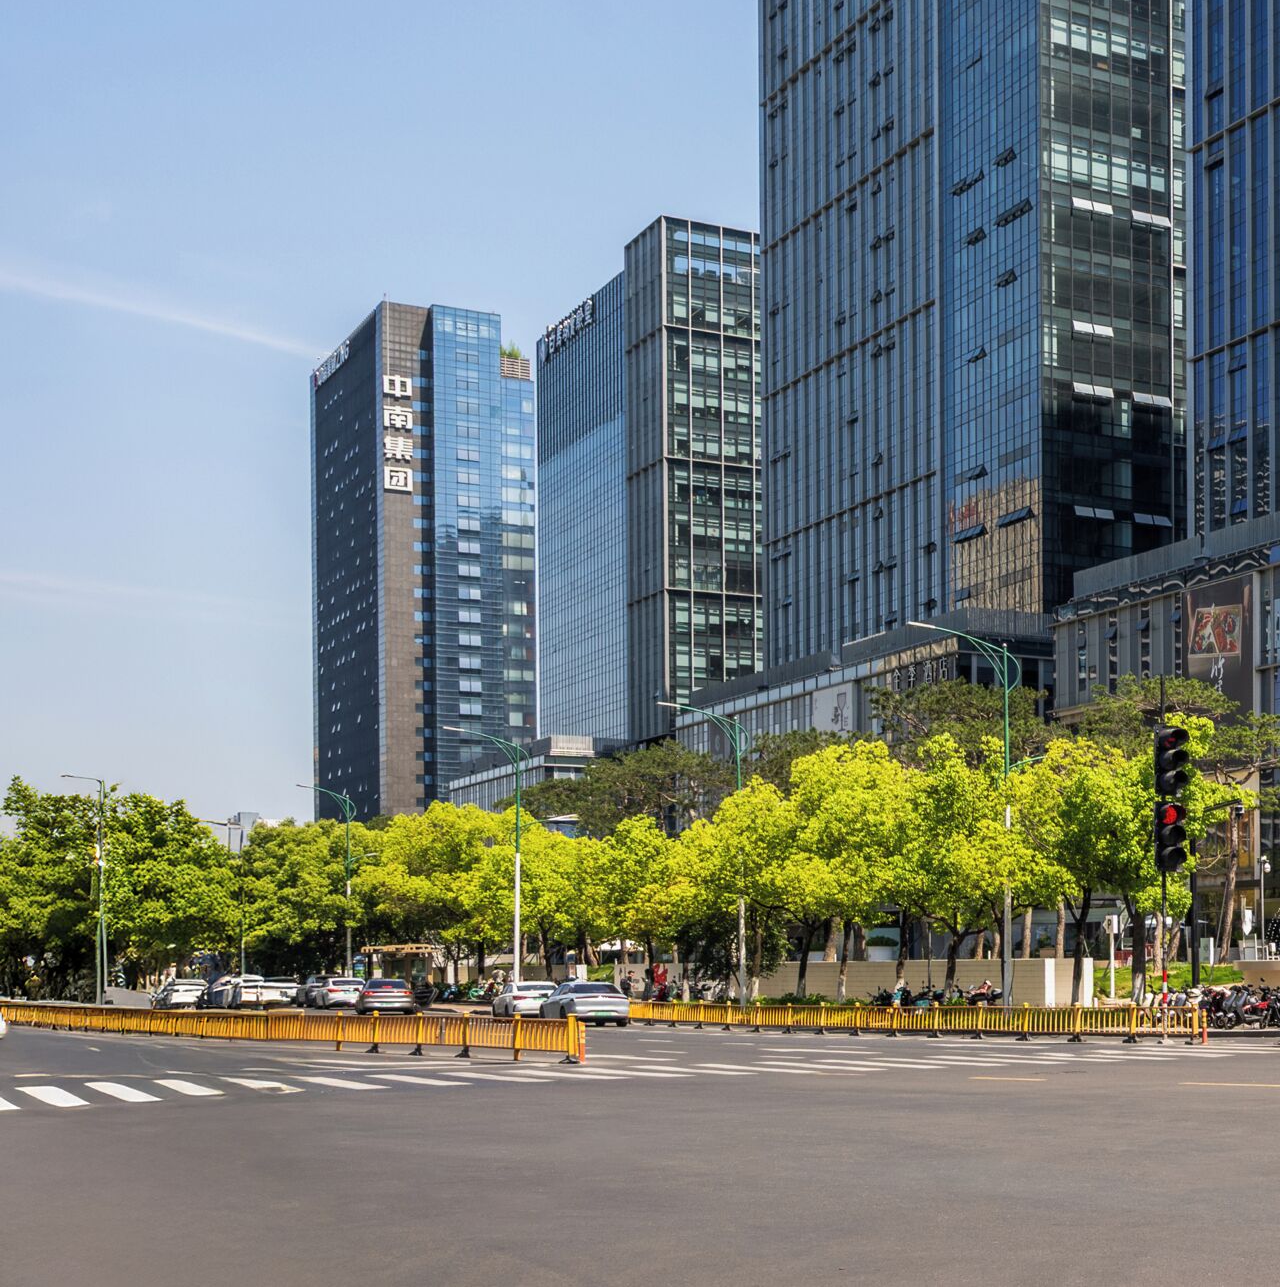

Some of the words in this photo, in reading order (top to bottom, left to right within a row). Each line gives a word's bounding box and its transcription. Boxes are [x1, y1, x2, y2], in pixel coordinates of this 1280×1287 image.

[382, 374, 414, 492] 中南集团
[893, 656, 950, 692] 全季酒店
